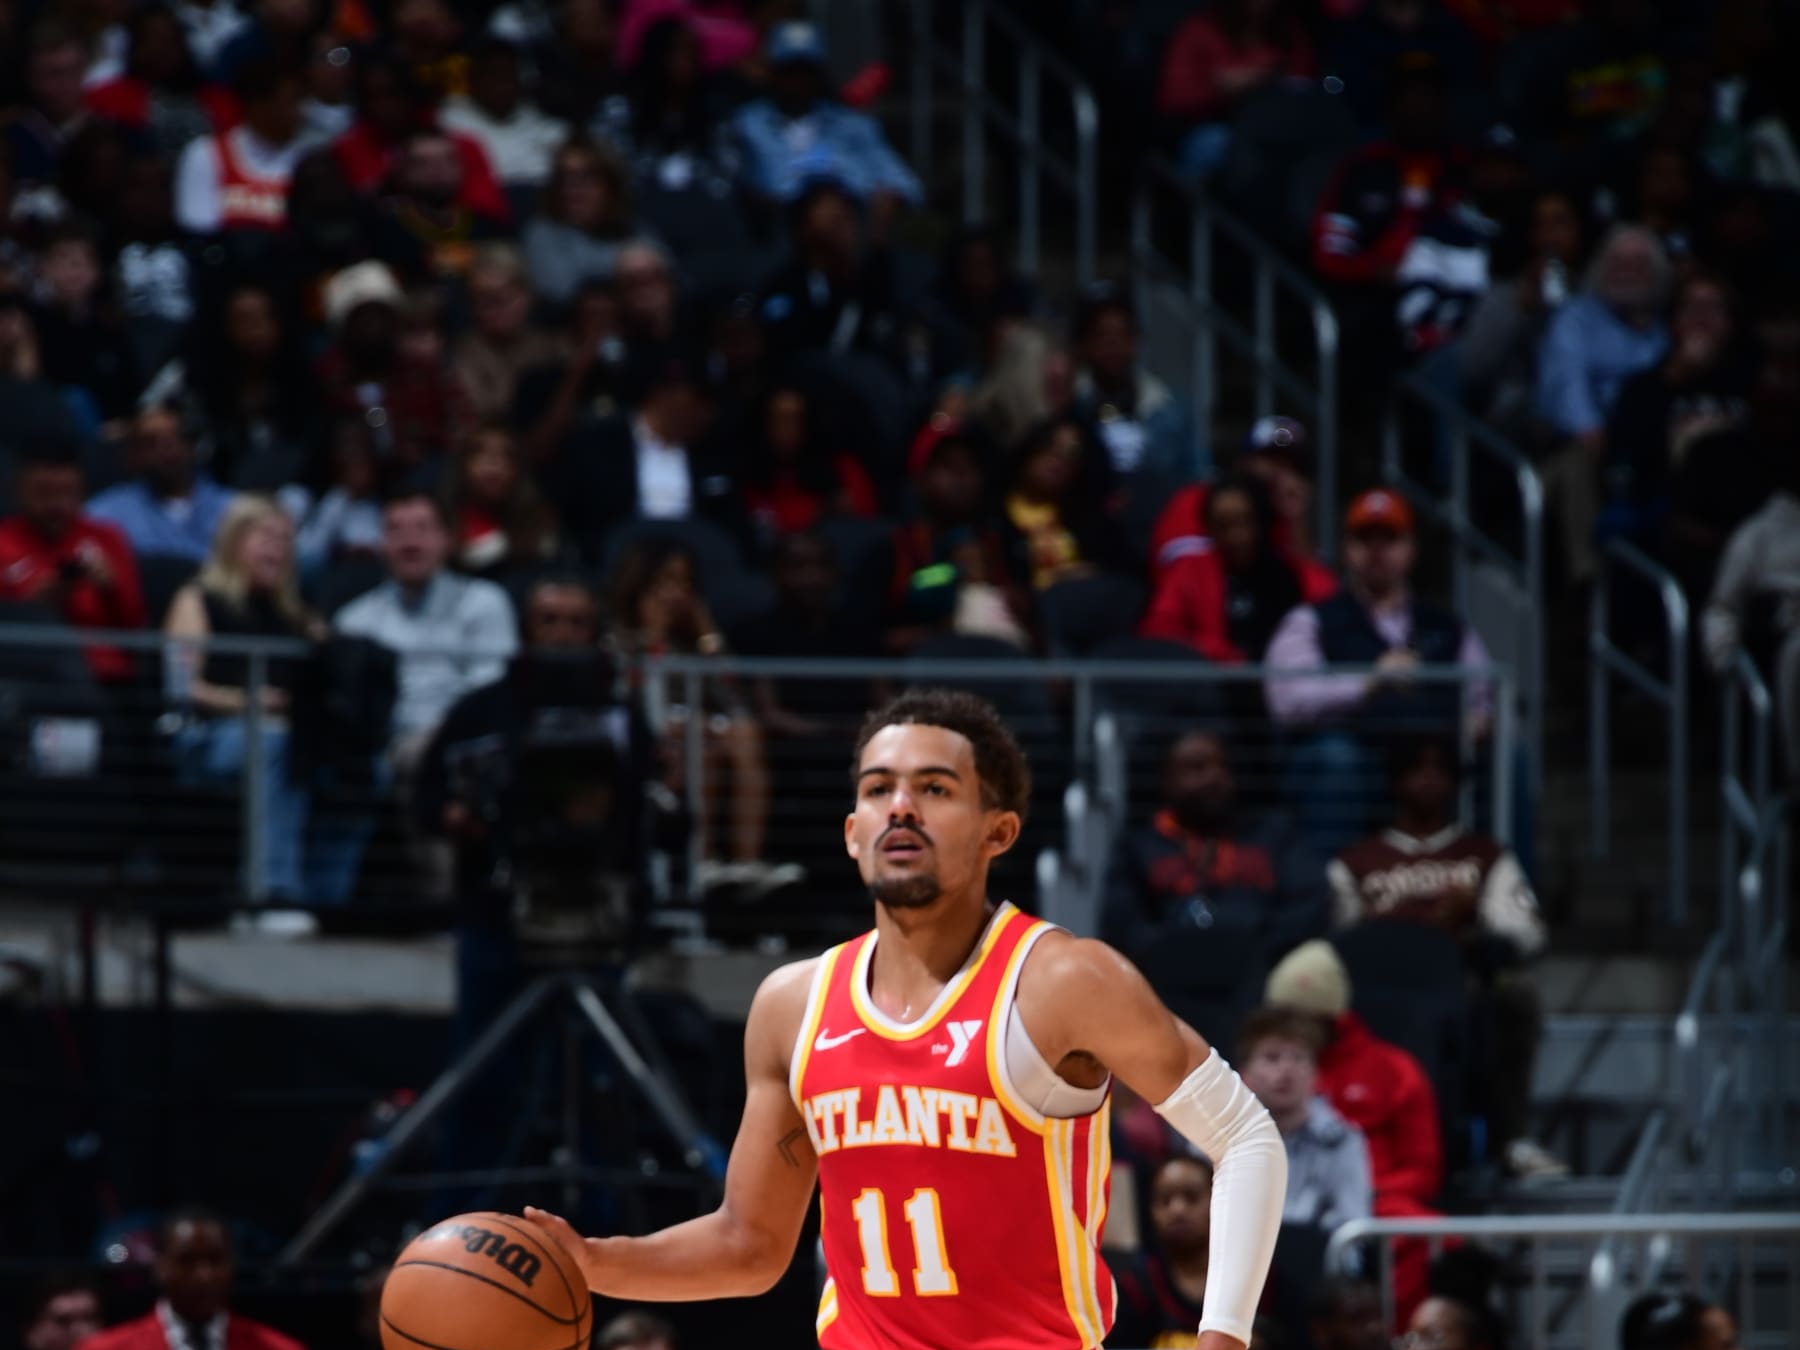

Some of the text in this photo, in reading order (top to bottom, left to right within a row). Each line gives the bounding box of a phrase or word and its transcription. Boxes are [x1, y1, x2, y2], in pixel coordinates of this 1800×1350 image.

[944, 1020, 983, 1067] Y
[426, 1225, 541, 1289] Wils
[852, 1187, 960, 1297] 11
